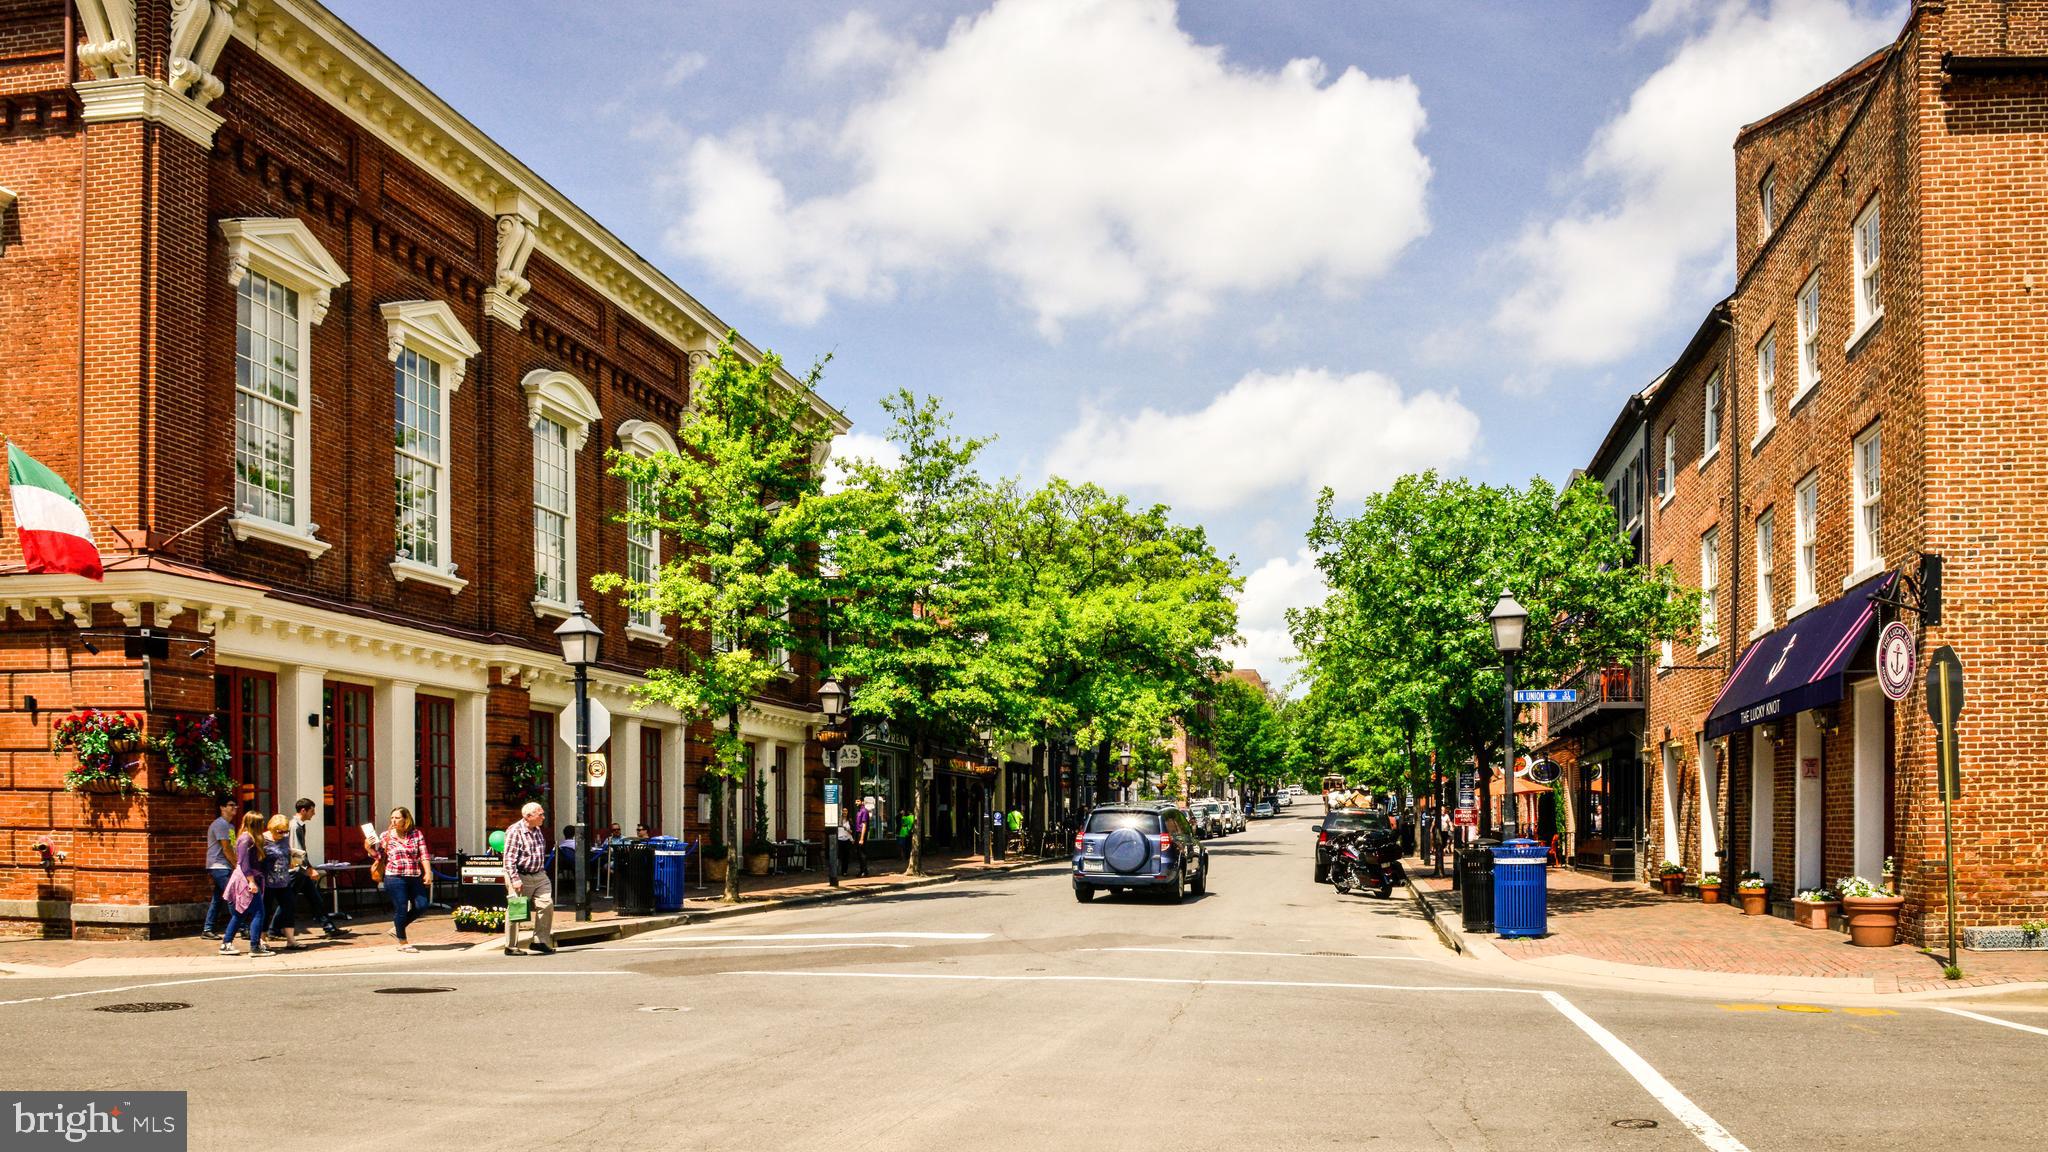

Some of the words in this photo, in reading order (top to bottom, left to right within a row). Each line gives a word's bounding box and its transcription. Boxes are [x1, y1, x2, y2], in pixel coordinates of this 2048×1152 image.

[1889, 627, 1904, 638] LUCKY
[1519, 691, 1524, 701] N
[1526, 691, 1545, 701] UNION
[1740, 710, 1749, 725] THE
[1749, 703, 1766, 722] LUCKY
[1765, 699, 1781, 717] KNOT
